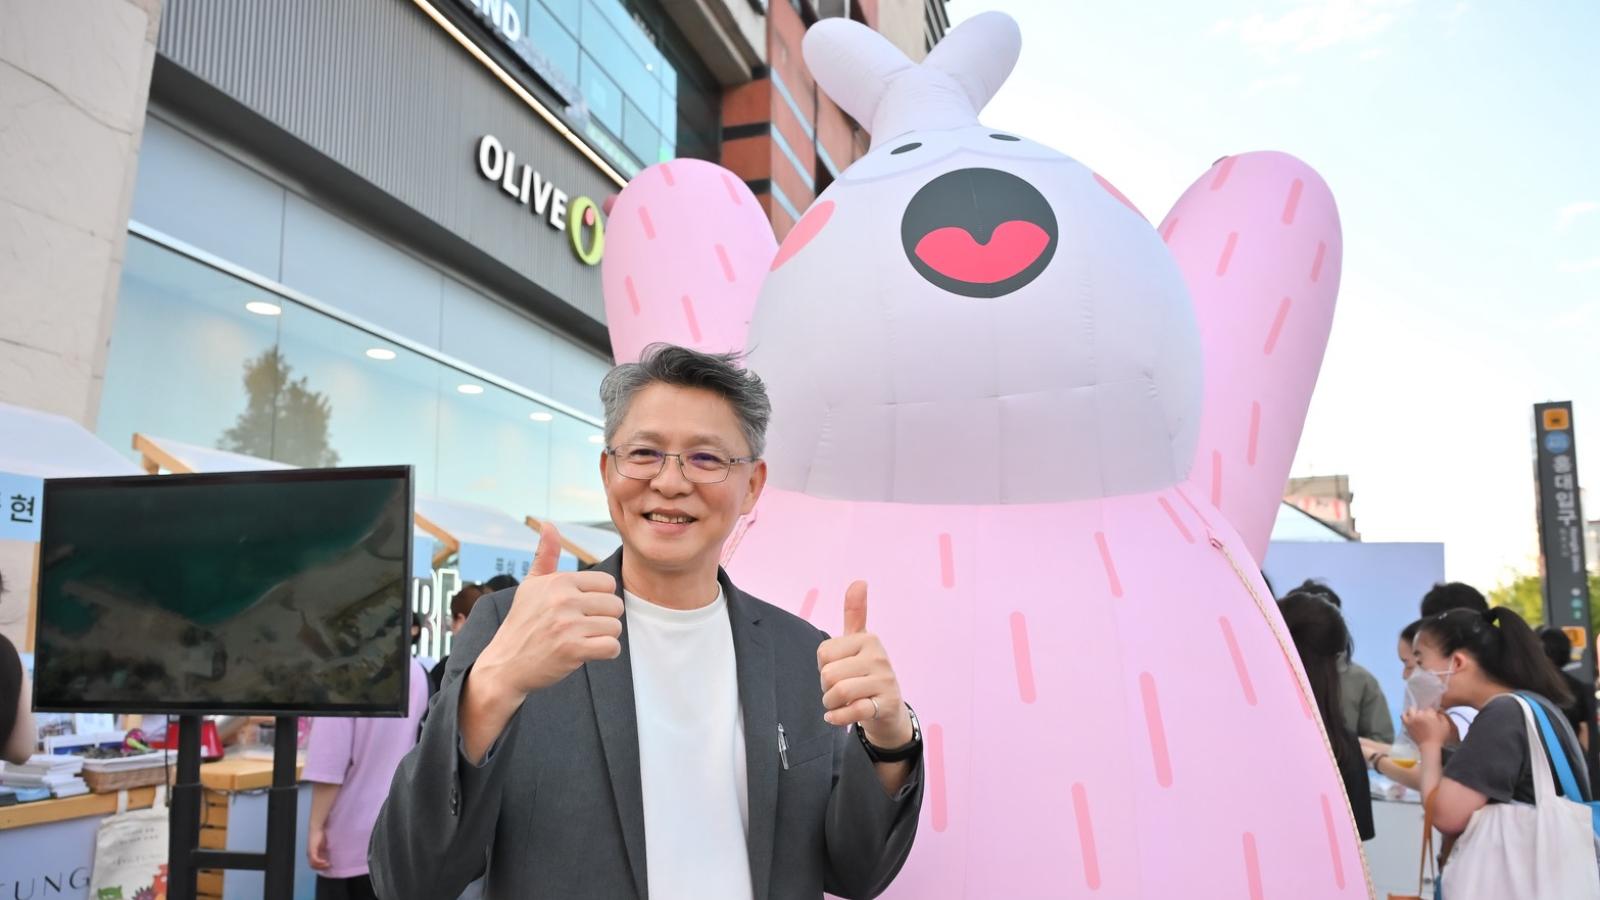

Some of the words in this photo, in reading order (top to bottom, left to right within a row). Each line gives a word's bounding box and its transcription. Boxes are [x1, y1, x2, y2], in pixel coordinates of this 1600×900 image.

[470, 0, 521, 42] ND
[479, 134, 569, 231] OLIVE
[1552, 454, 1577, 526] 홍대입구
[0, 866, 92, 900] UNG
